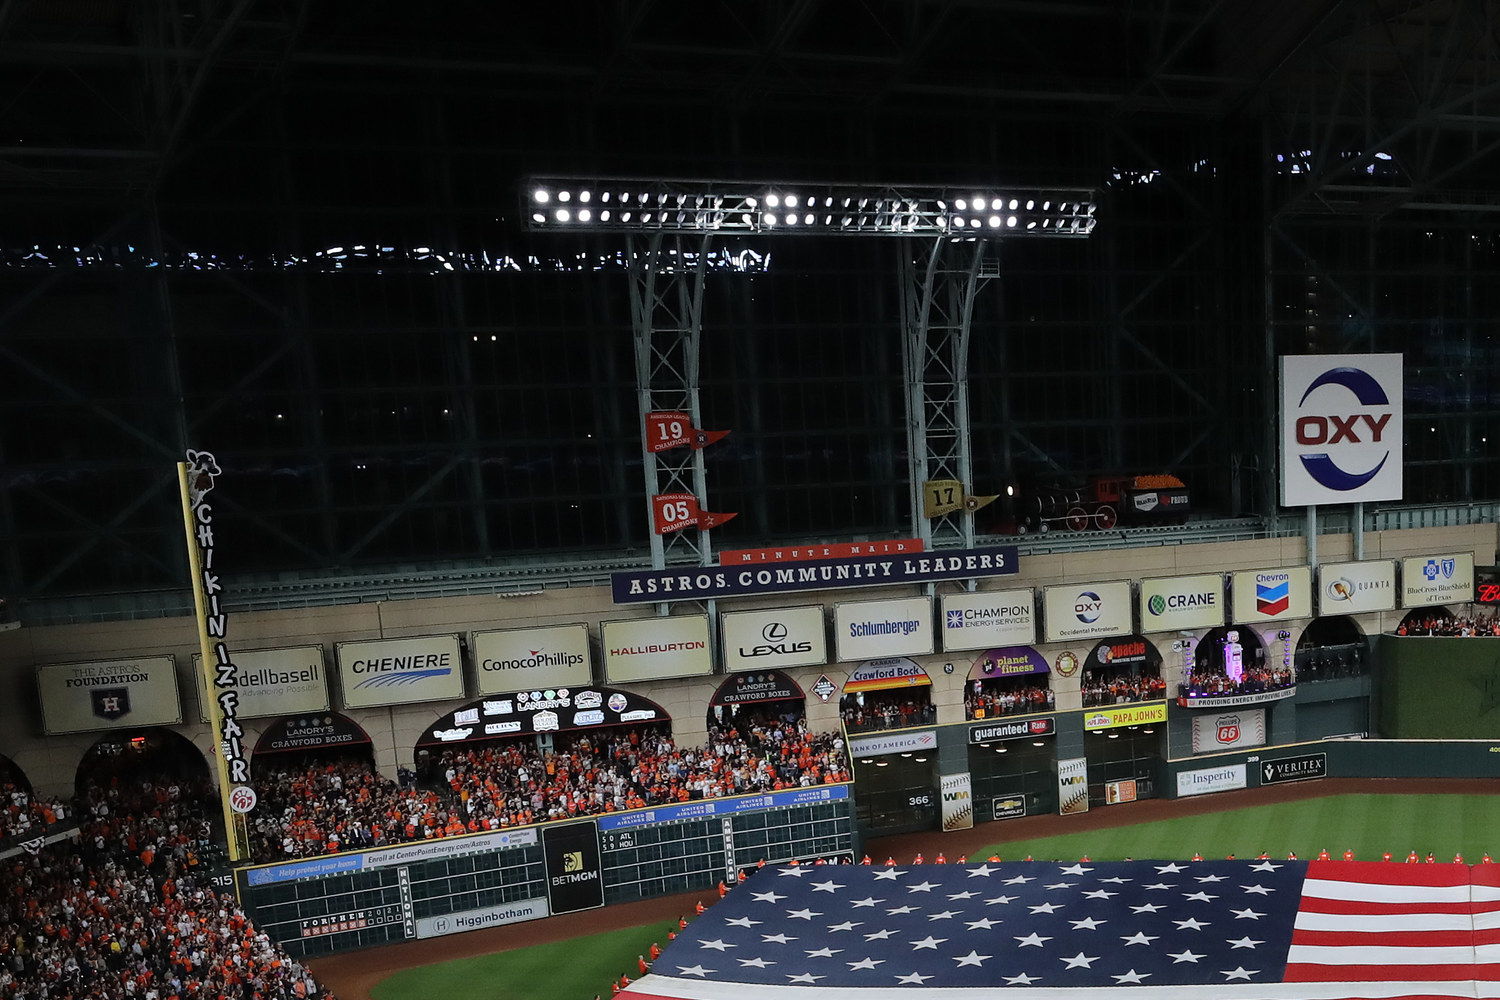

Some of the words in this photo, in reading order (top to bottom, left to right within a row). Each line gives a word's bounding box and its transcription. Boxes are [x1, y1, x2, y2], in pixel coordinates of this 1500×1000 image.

[658, 422, 682, 440] 19
[1296, 414, 1392, 445] OXY
[655, 438, 690, 450] CHAMPIONS
[933, 488, 954, 506] 17
[663, 501, 689, 522] 05
[662, 518, 698, 533] CHAMPIONS
[743, 548, 830, 561] MINUTE
[197, 503, 226, 637] CHIKIN
[629, 574, 726, 595] ASTROS
[738, 562, 894, 587] COMMUNITY
[904, 554, 1005, 575] LEADERS
[1256, 573, 1289, 583] Chevron
[1359, 581, 1390, 591] QUANTA
[1407, 586, 1437, 595] BlueCross
[1438, 582, 1470, 592] BlueShield
[1168, 593, 1215, 607] CRANE
[965, 606, 1029, 619] CHAMPION
[1075, 602, 1102, 613] OXY
[850, 618, 920, 638] Schlumberger
[965, 619, 995, 627] ENERGY
[996, 617, 1030, 625] SERVICES
[1060, 628, 1090, 636] Occidental
[610, 640, 705, 657] HALLIBURTON
[739, 641, 812, 658] LEXUS
[1112, 642, 1146, 658] apache
[352, 652, 450, 675] CHENIERE
[483, 651, 584, 672] ConocoPhillips
[997, 655, 1028, 668] planet
[72, 668, 94, 677] THE
[98, 665, 140, 675] ASTROS
[854, 669, 894, 681] Crawford
[897, 666, 919, 675] Bock
[1001, 663, 1034, 674] fitness
[66, 673, 149, 687] FOUNDATION
[737, 682, 776, 691] LANDRY'S
[724, 692, 766, 702] CRAWFORD
[768, 690, 791, 698] BOXES
[517, 699, 570, 711] LANDRY'S
[1113, 713, 1132, 723] PAPA
[1135, 710, 1163, 722] JOHN'S
[220, 693, 246, 781] FAIR
[287, 726, 334, 737] LANDRY'S
[975, 723, 1028, 741] guaranteed
[1031, 722, 1046, 731] Rate
[1220, 728, 1236, 738] 66
[272, 737, 322, 749] CRAWFORD
[325, 734, 353, 743] BOXES
[883, 740, 916, 749] AMERICA
[1277, 759, 1321, 772] VERITEX
[1060, 776, 1084, 786] WM
[1193, 770, 1236, 784] Insperity
[909, 795, 929, 806] 366
[944, 791, 969, 801] WM
[620, 833, 632, 841] ATL
[619, 841, 634, 849] HOU
[724, 820, 735, 880] AMERICAN
[368, 853, 387, 864] Enroll
[396, 840, 490, 860] CenterPointEnergy.com/Astros
[279, 868, 295, 877] Help
[297, 865, 319, 875] protect
[320, 862, 336, 871] your
[211, 875, 232, 886] 315
[552, 870, 597, 886] BETMGM
[400, 870, 412, 935] NATIONAL
[456, 907, 532, 928] Higginbotham
